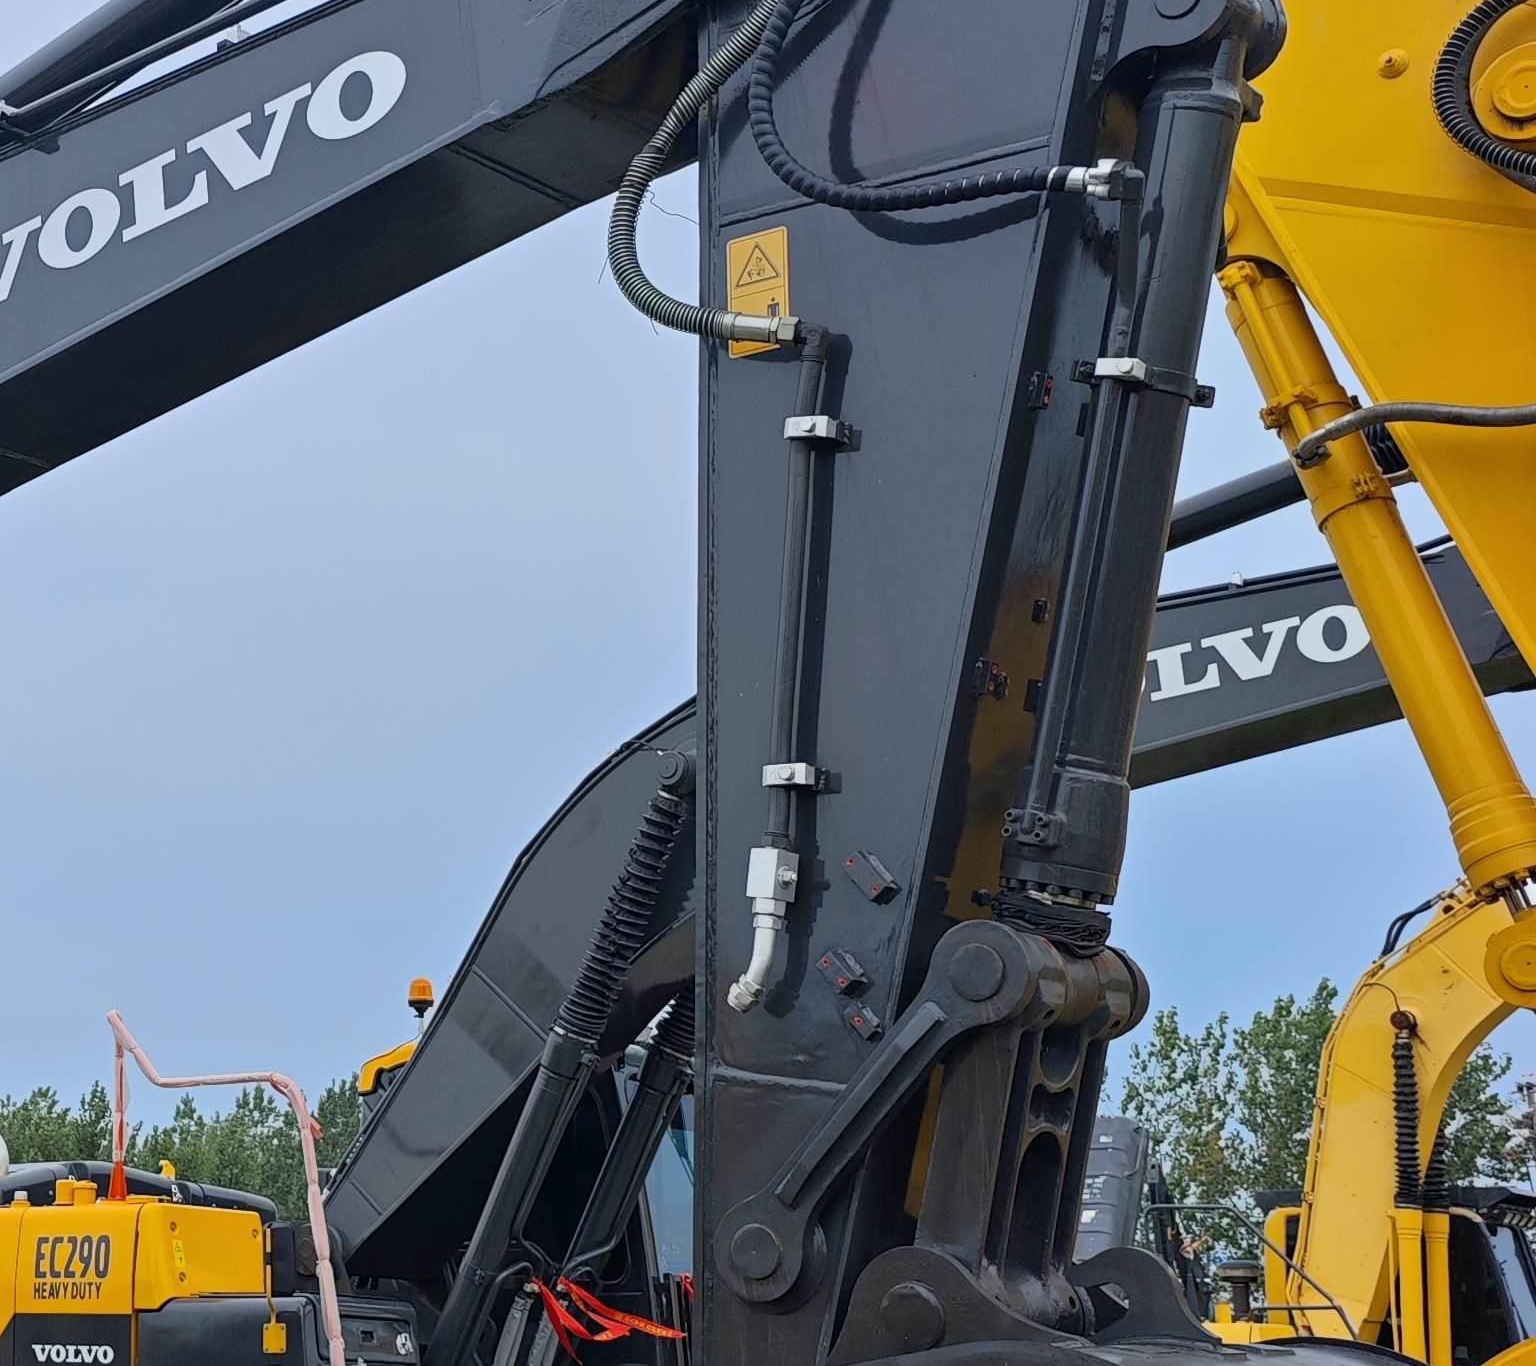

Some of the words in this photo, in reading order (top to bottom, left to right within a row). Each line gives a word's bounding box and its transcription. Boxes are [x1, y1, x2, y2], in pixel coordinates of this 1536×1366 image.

[1141, 604, 1371, 702] LVO
[34, 1234, 112, 1279] EC290
[31, 1343, 116, 1365] VOLVO
